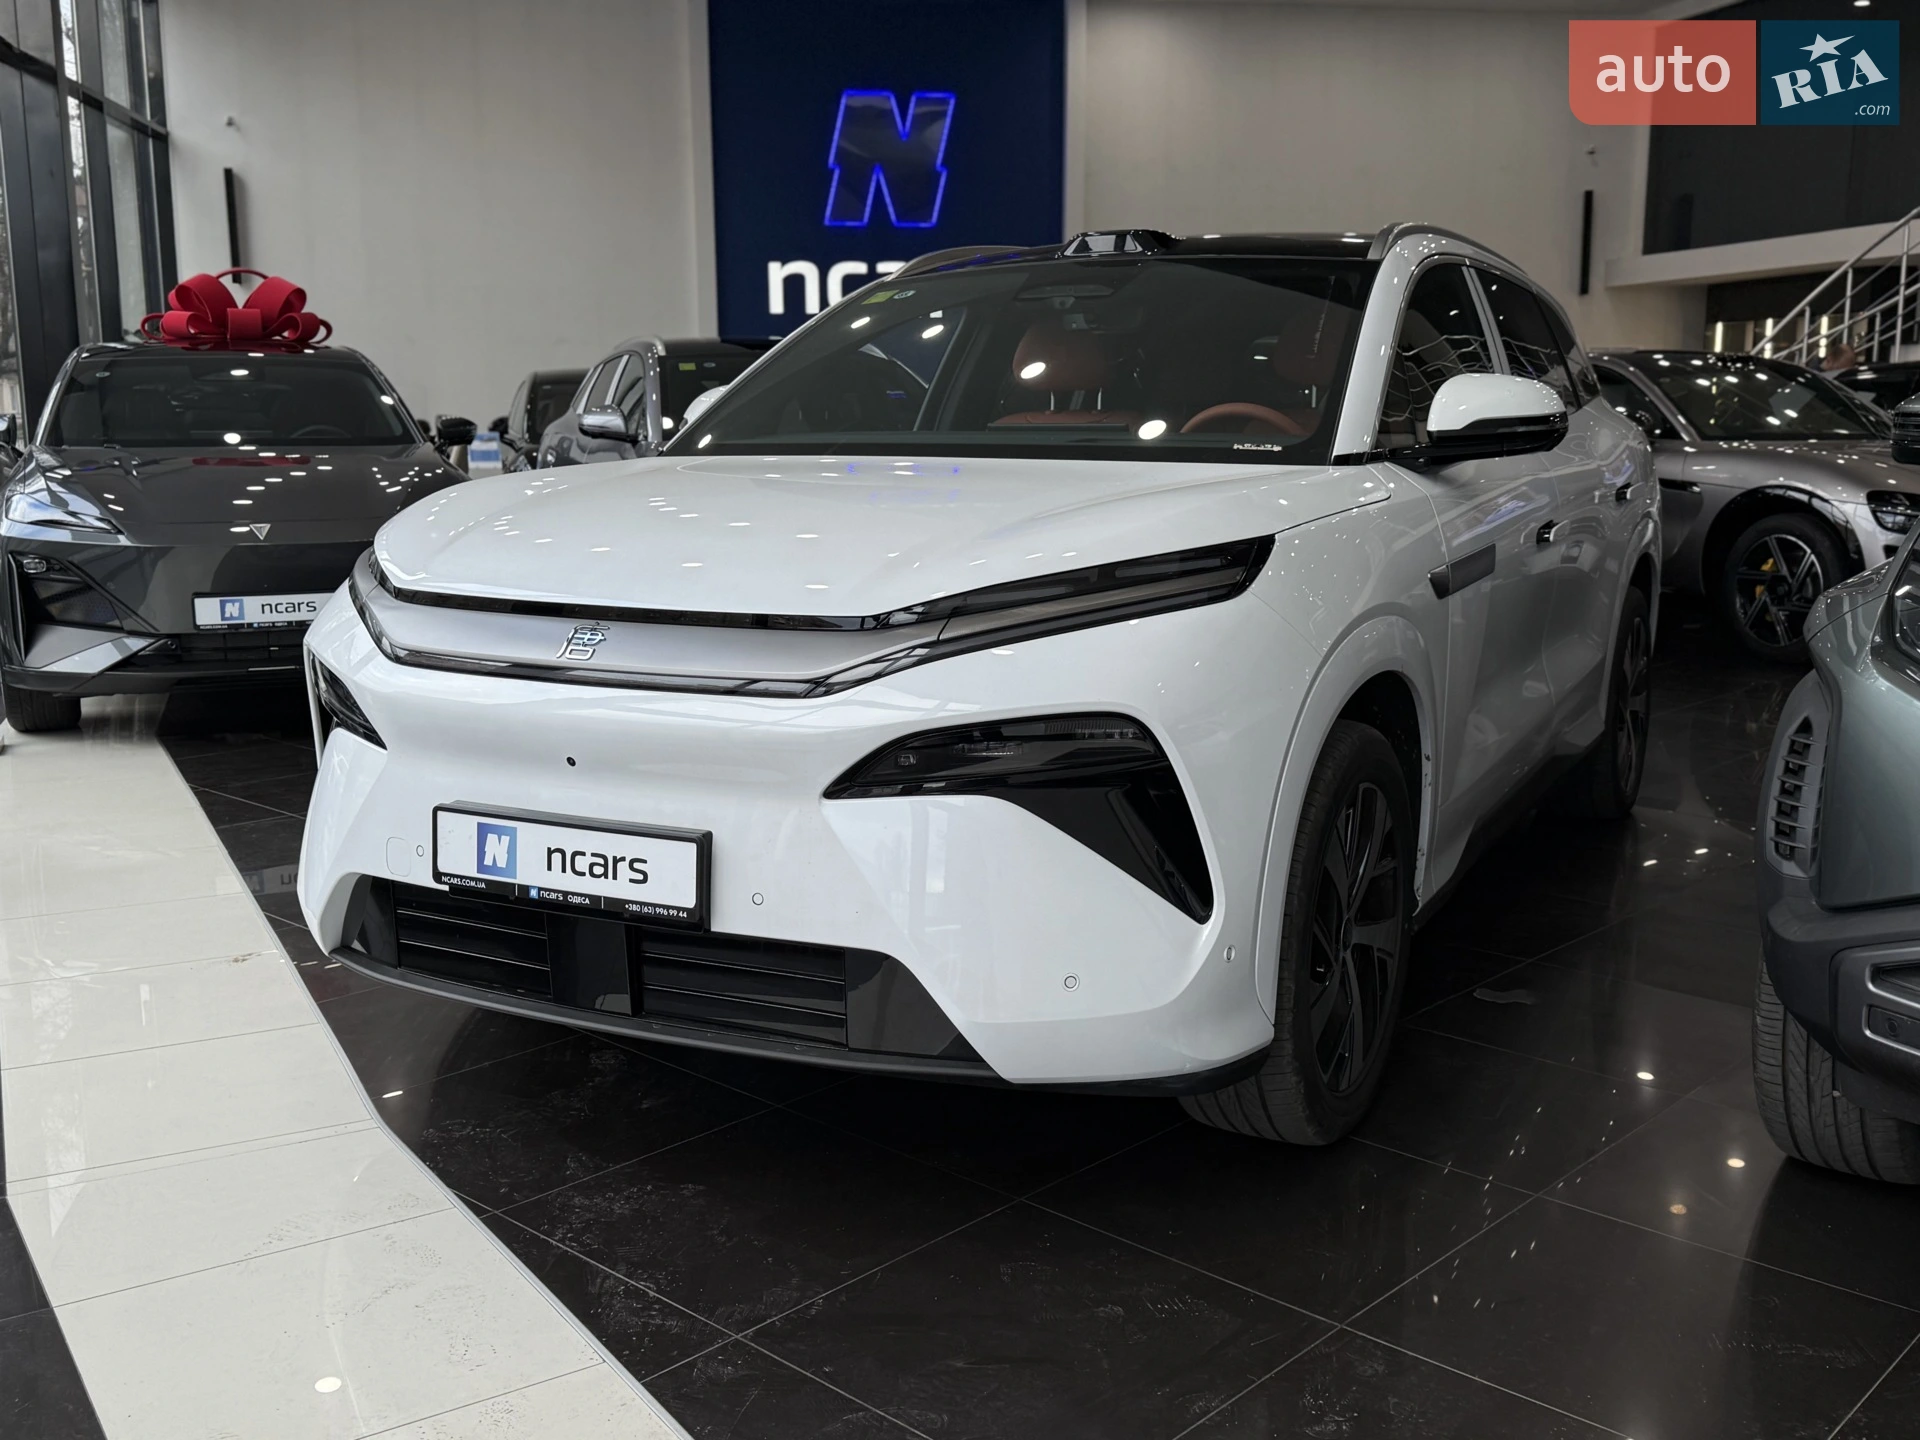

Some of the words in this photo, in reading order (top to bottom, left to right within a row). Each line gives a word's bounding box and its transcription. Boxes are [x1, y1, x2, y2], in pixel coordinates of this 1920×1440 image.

[824, 88, 956, 228] N
[767, 260, 906, 315] nc
[261, 600, 317, 615] ncars
[483, 833, 511, 868] N
[546, 846, 649, 885] ncars
[441, 875, 486, 889] NCARS.COM.UA
[540, 890, 563, 900] ncars
[567, 894, 590, 905] ОДЕСА
[625, 903, 641, 912] +380
[641, 906, 655, 915] (63)
[655, 907, 668, 916] 996
[669, 909, 678, 917] 99
[678, 910, 687, 918] 44
